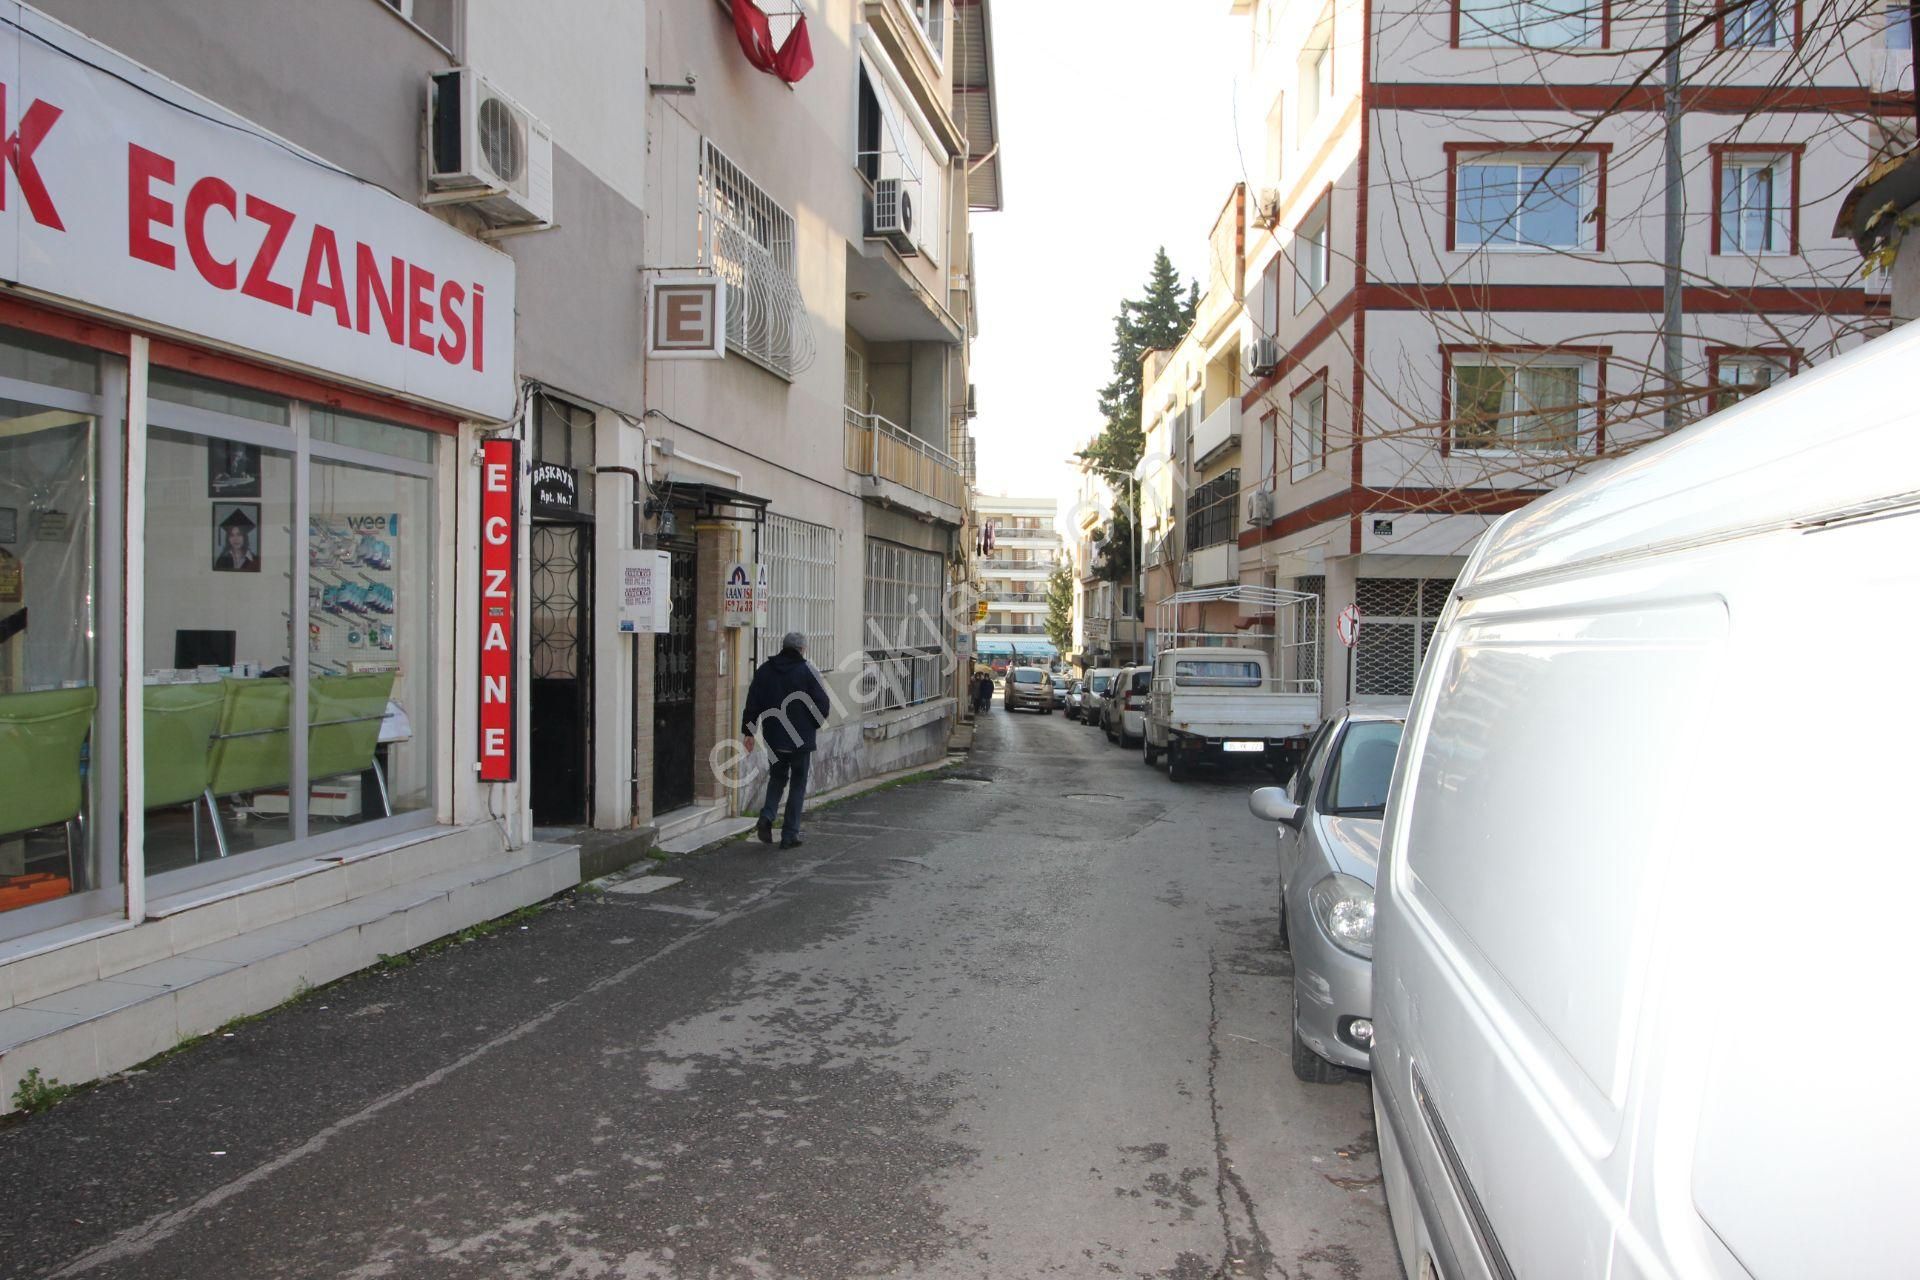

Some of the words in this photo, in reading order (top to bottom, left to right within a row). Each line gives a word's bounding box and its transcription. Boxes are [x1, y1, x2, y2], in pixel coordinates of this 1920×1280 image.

[129, 142, 484, 373] ECZANESİ
[667, 295, 704, 341] E
[533, 465, 575, 494] BAŞKAYA
[540, 489, 555, 504] Apt.
[347, 515, 386, 531] wee
[483, 463, 508, 757] ECZANE
